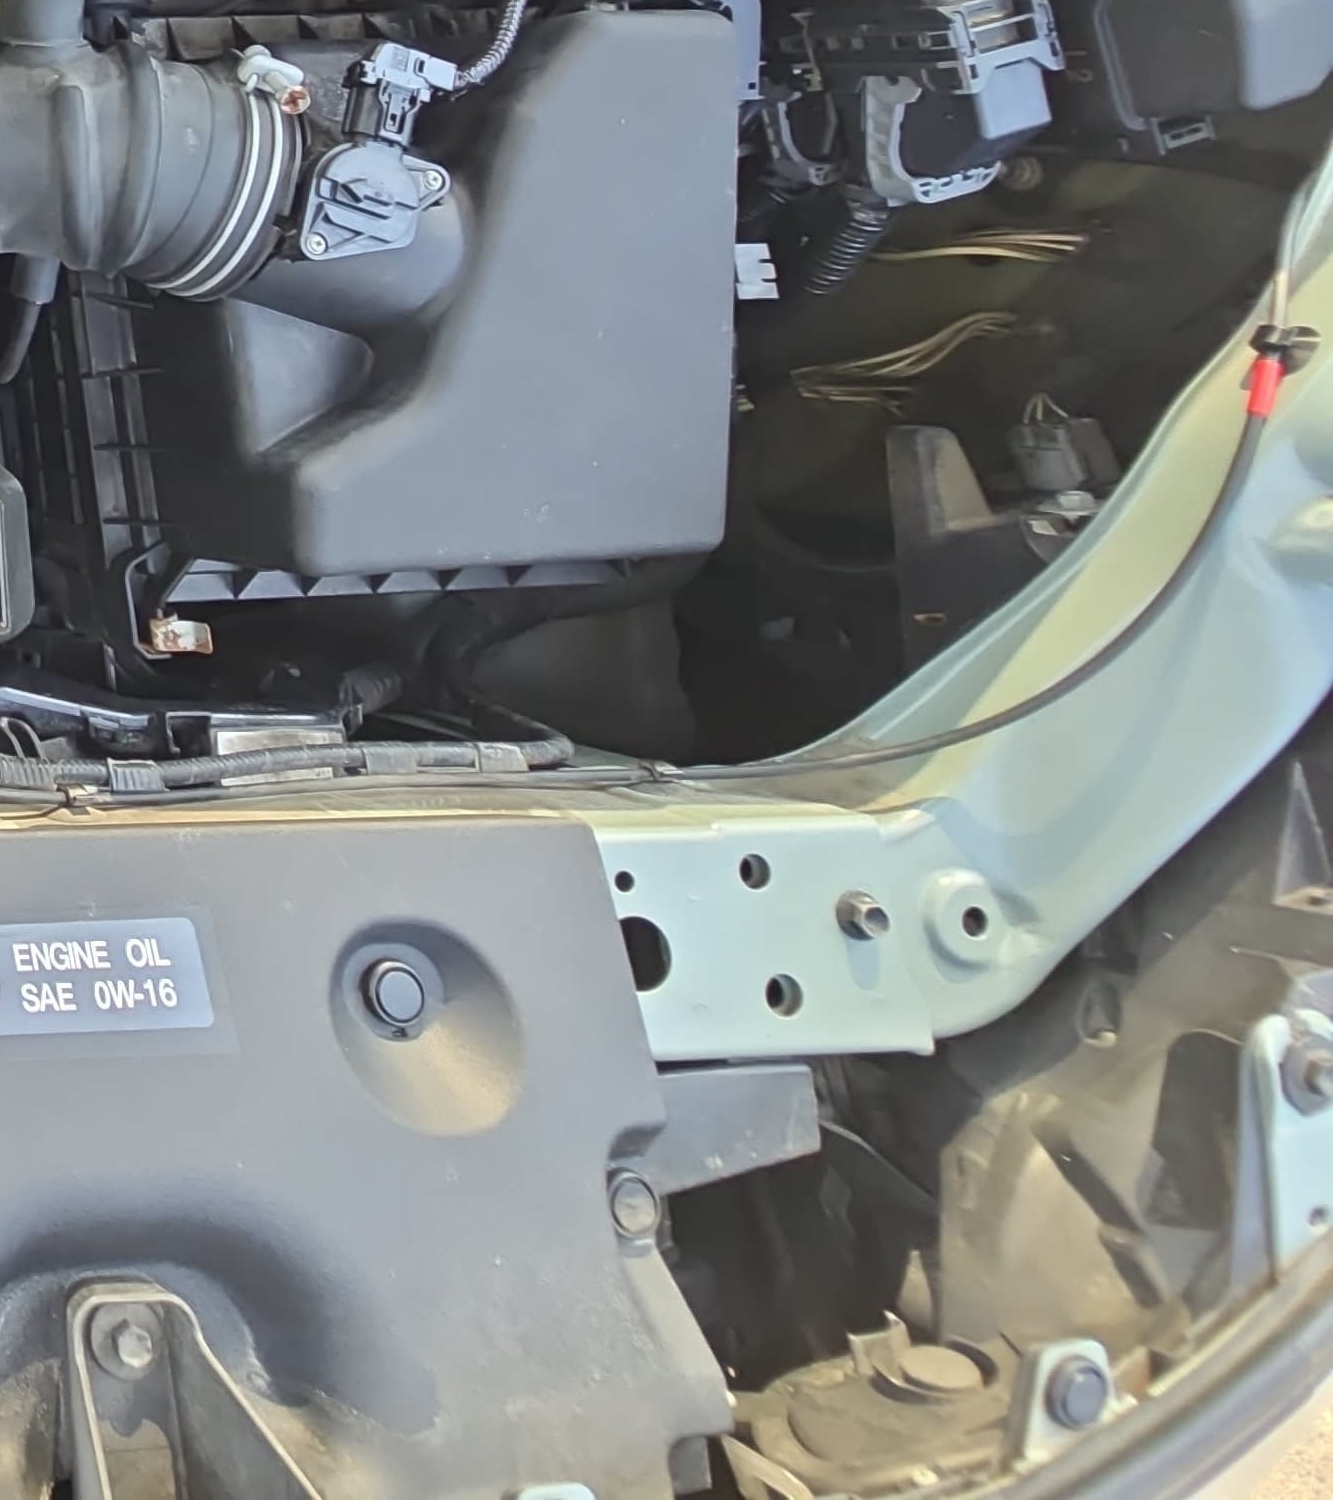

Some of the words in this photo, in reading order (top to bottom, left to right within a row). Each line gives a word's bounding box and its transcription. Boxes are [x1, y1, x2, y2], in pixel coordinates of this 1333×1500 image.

[12, 940, 111, 973] ENGINE
[125, 938, 171, 968] OIL
[21, 982, 77, 1014] SAE
